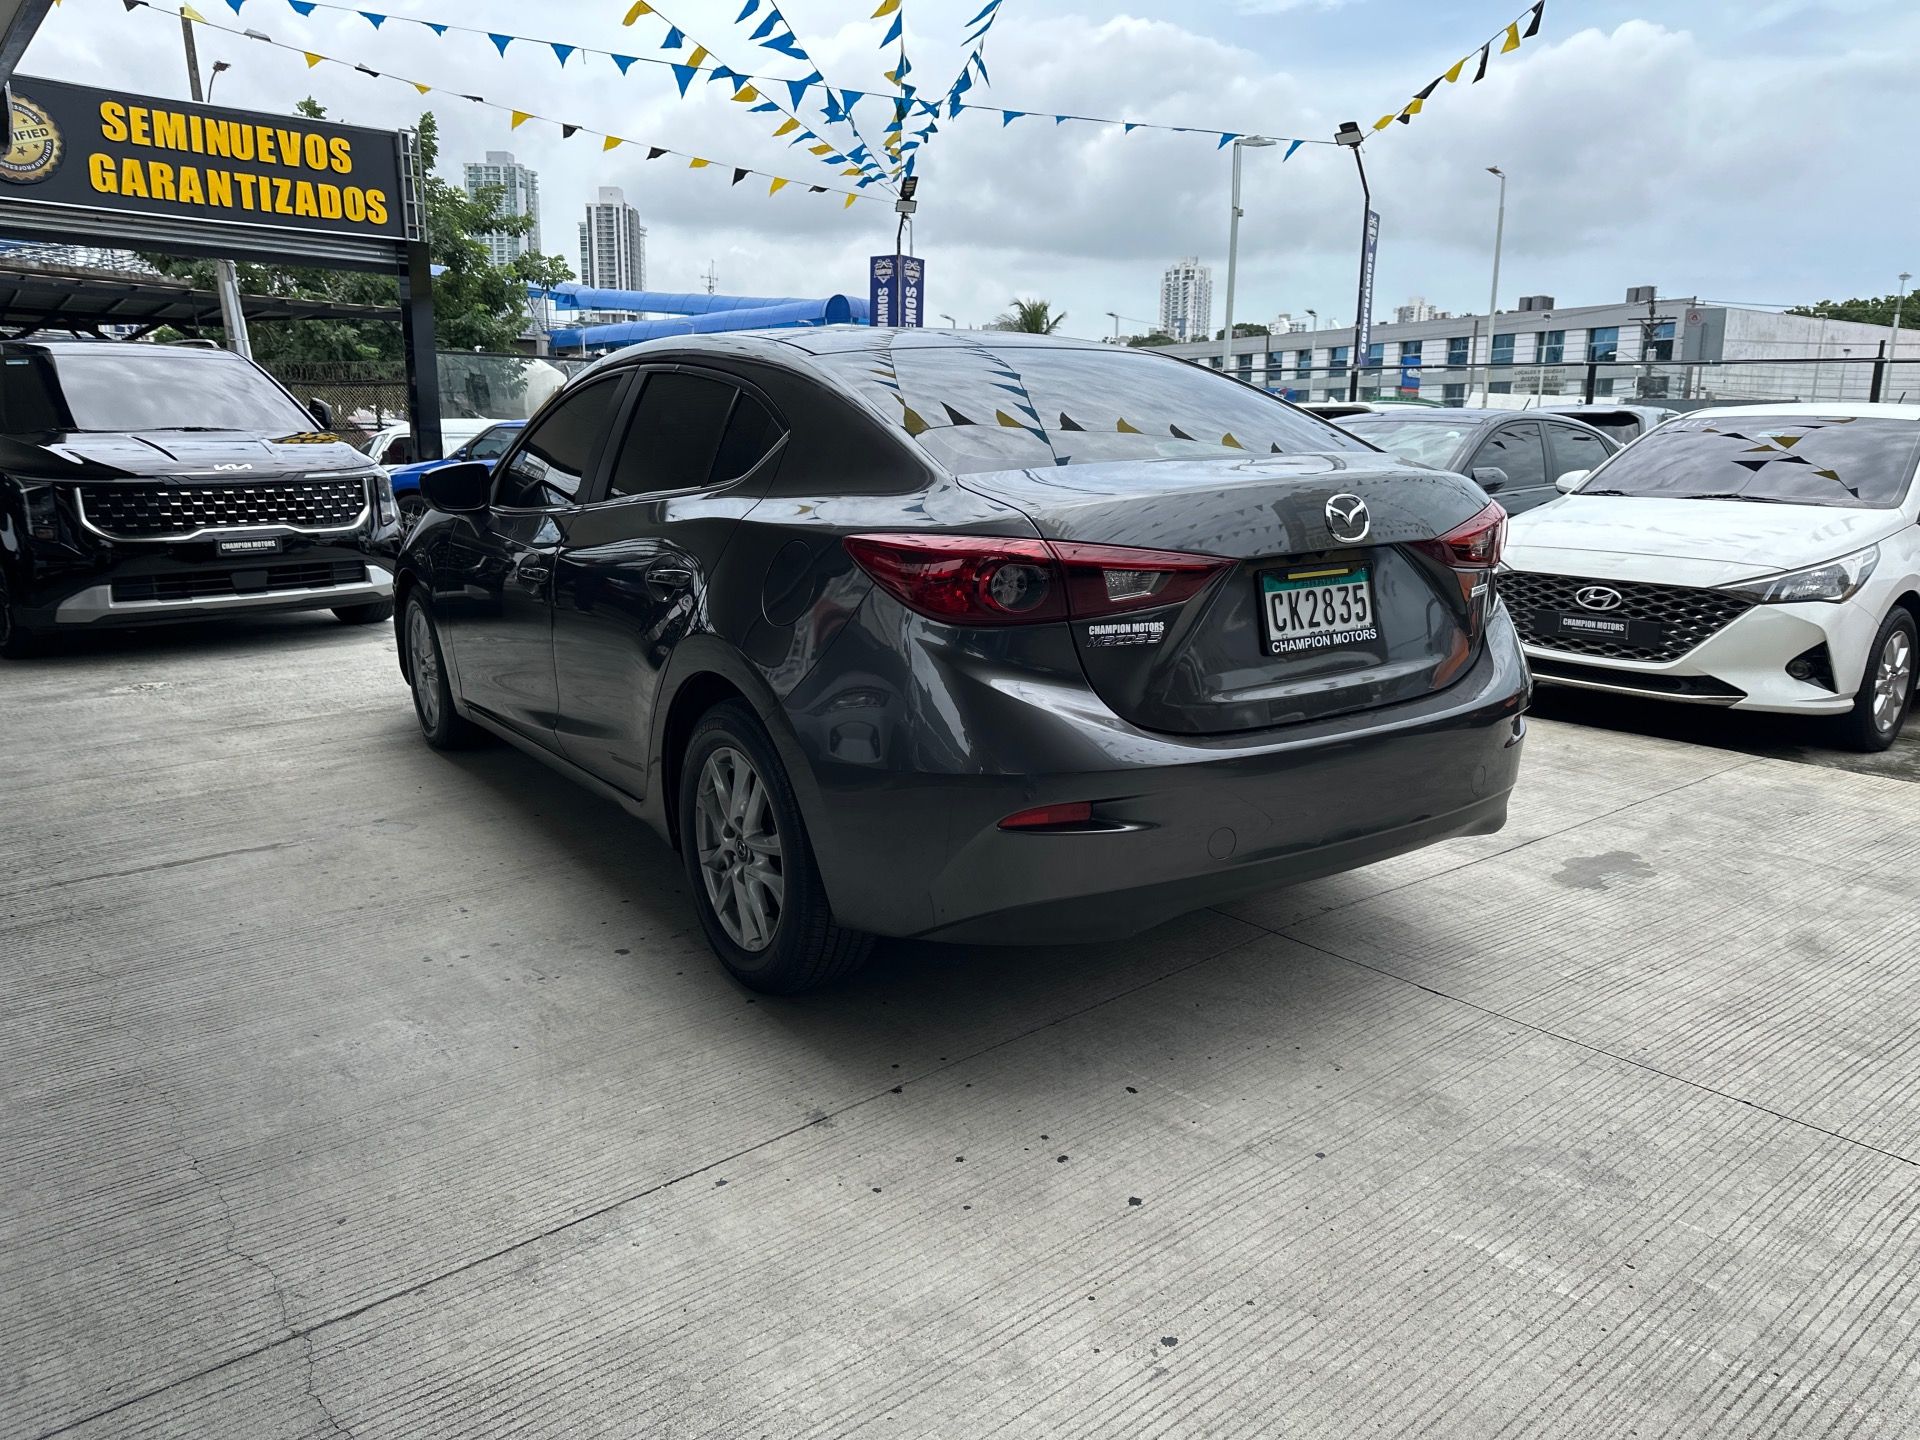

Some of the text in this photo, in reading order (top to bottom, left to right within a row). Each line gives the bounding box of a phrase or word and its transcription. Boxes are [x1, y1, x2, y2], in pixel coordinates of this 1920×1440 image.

[100, 101, 353, 174] SEMINUEVOS
[89, 153, 388, 225] GARANTIZADOS
[221, 540, 276, 550] CHAMPION MOTORS
[1271, 584, 1367, 632] CK2835
[1089, 621, 1165, 635] CHAMPION MOTORS
[1562, 617, 1596, 628] CHAMPION
[1597, 621, 1625, 631] MOTORS
[1271, 628, 1378, 653] CHAMPION MOTORS
